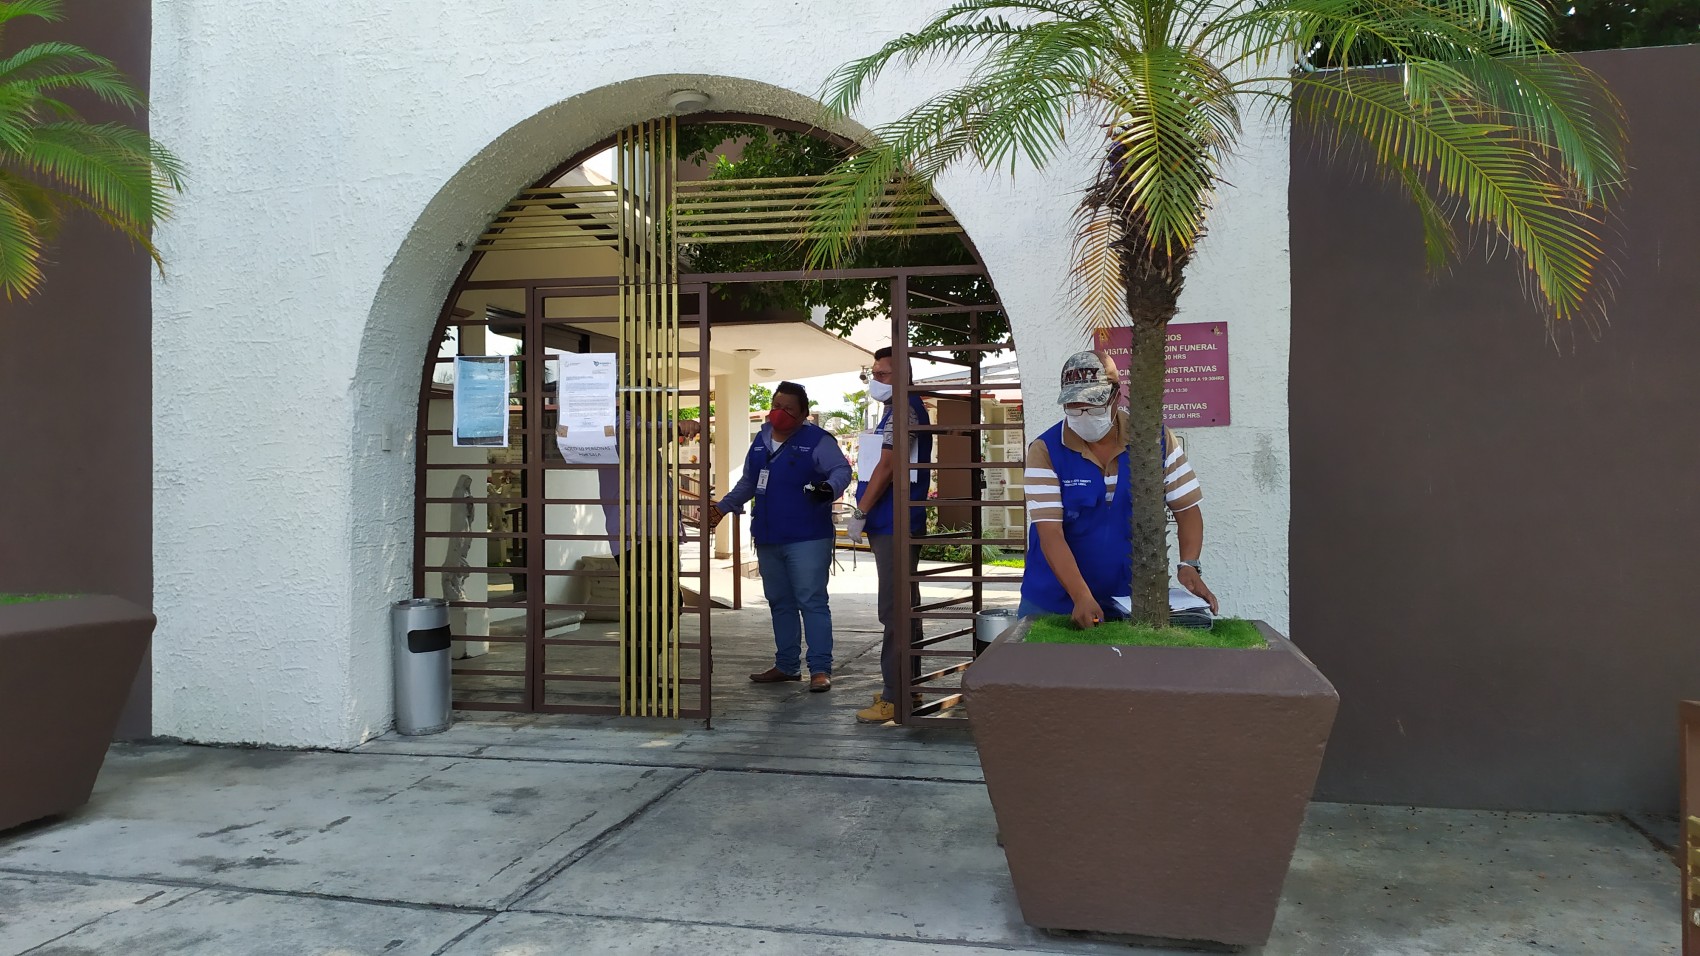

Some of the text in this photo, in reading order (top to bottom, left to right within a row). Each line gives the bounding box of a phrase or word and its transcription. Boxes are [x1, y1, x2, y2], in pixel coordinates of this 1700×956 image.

[1103, 347, 1129, 355] VISITA
[1179, 343, 1218, 351] FUNERAL
[1064, 367, 1099, 382] NAVY
[1165, 365, 1217, 374] NISTRATIVAS
[1163, 402, 1208, 411] PERATIVAS
